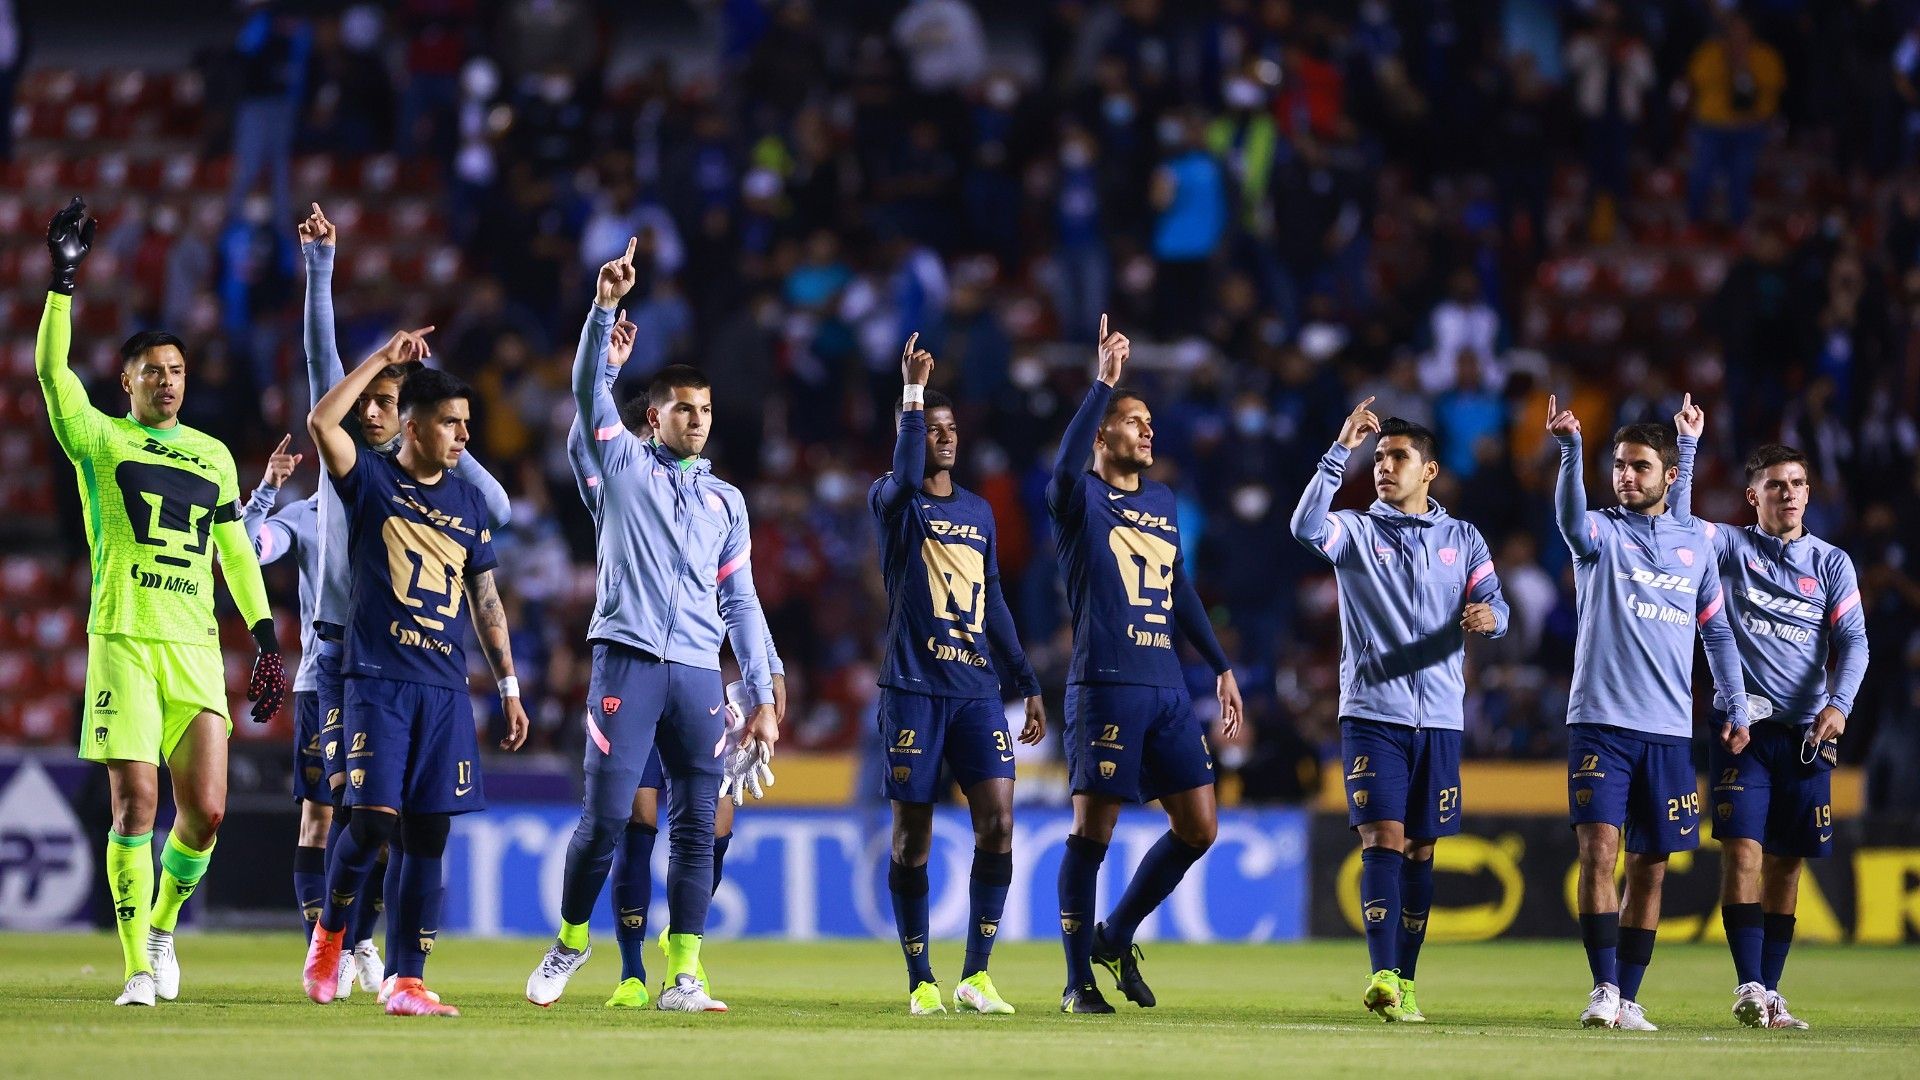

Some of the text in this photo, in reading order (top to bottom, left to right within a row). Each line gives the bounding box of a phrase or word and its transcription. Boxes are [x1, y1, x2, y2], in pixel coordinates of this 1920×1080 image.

[404, 495, 467, 532] DHL
[1122, 508, 1172, 531] DHL
[928, 520, 983, 541] DHL
[1378, 554, 1391, 565] 27
[163, 576, 199, 596] Mifel
[1630, 566, 1697, 595] DHL
[1747, 586, 1824, 620] DHL
[1659, 606, 1692, 626] Mifel
[1773, 622, 1812, 643] Mifel
[957, 648, 987, 668] Mifel
[992, 730, 1013, 752] 31
[457, 760, 472, 785] 17
[1439, 786, 1458, 812] 27
[1667, 791, 1700, 821] 249
[1814, 804, 1831, 828] 19
